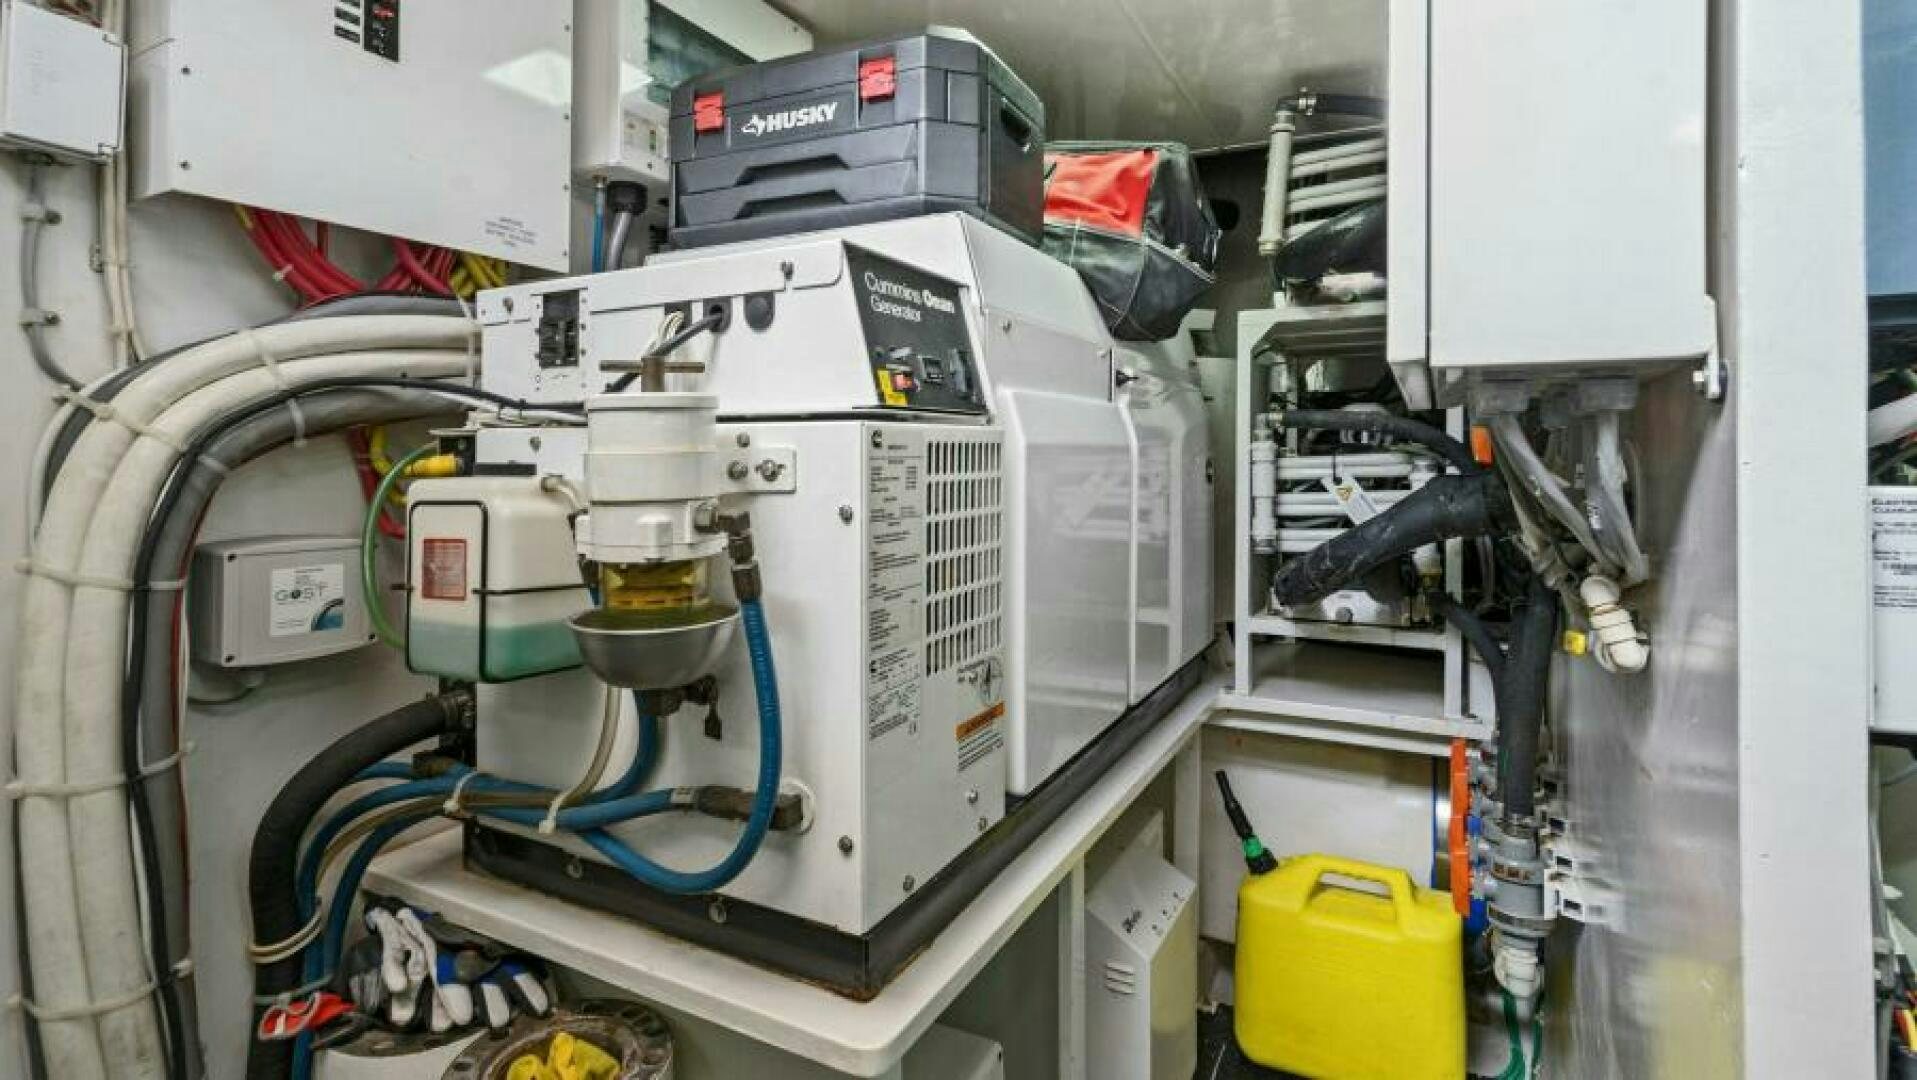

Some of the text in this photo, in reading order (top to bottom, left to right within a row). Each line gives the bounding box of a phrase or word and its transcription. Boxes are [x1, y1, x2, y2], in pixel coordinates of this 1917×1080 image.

[766, 102, 838, 132] HUSKY
[864, 272, 921, 304] Cummins
[871, 294, 921, 321] Generator
